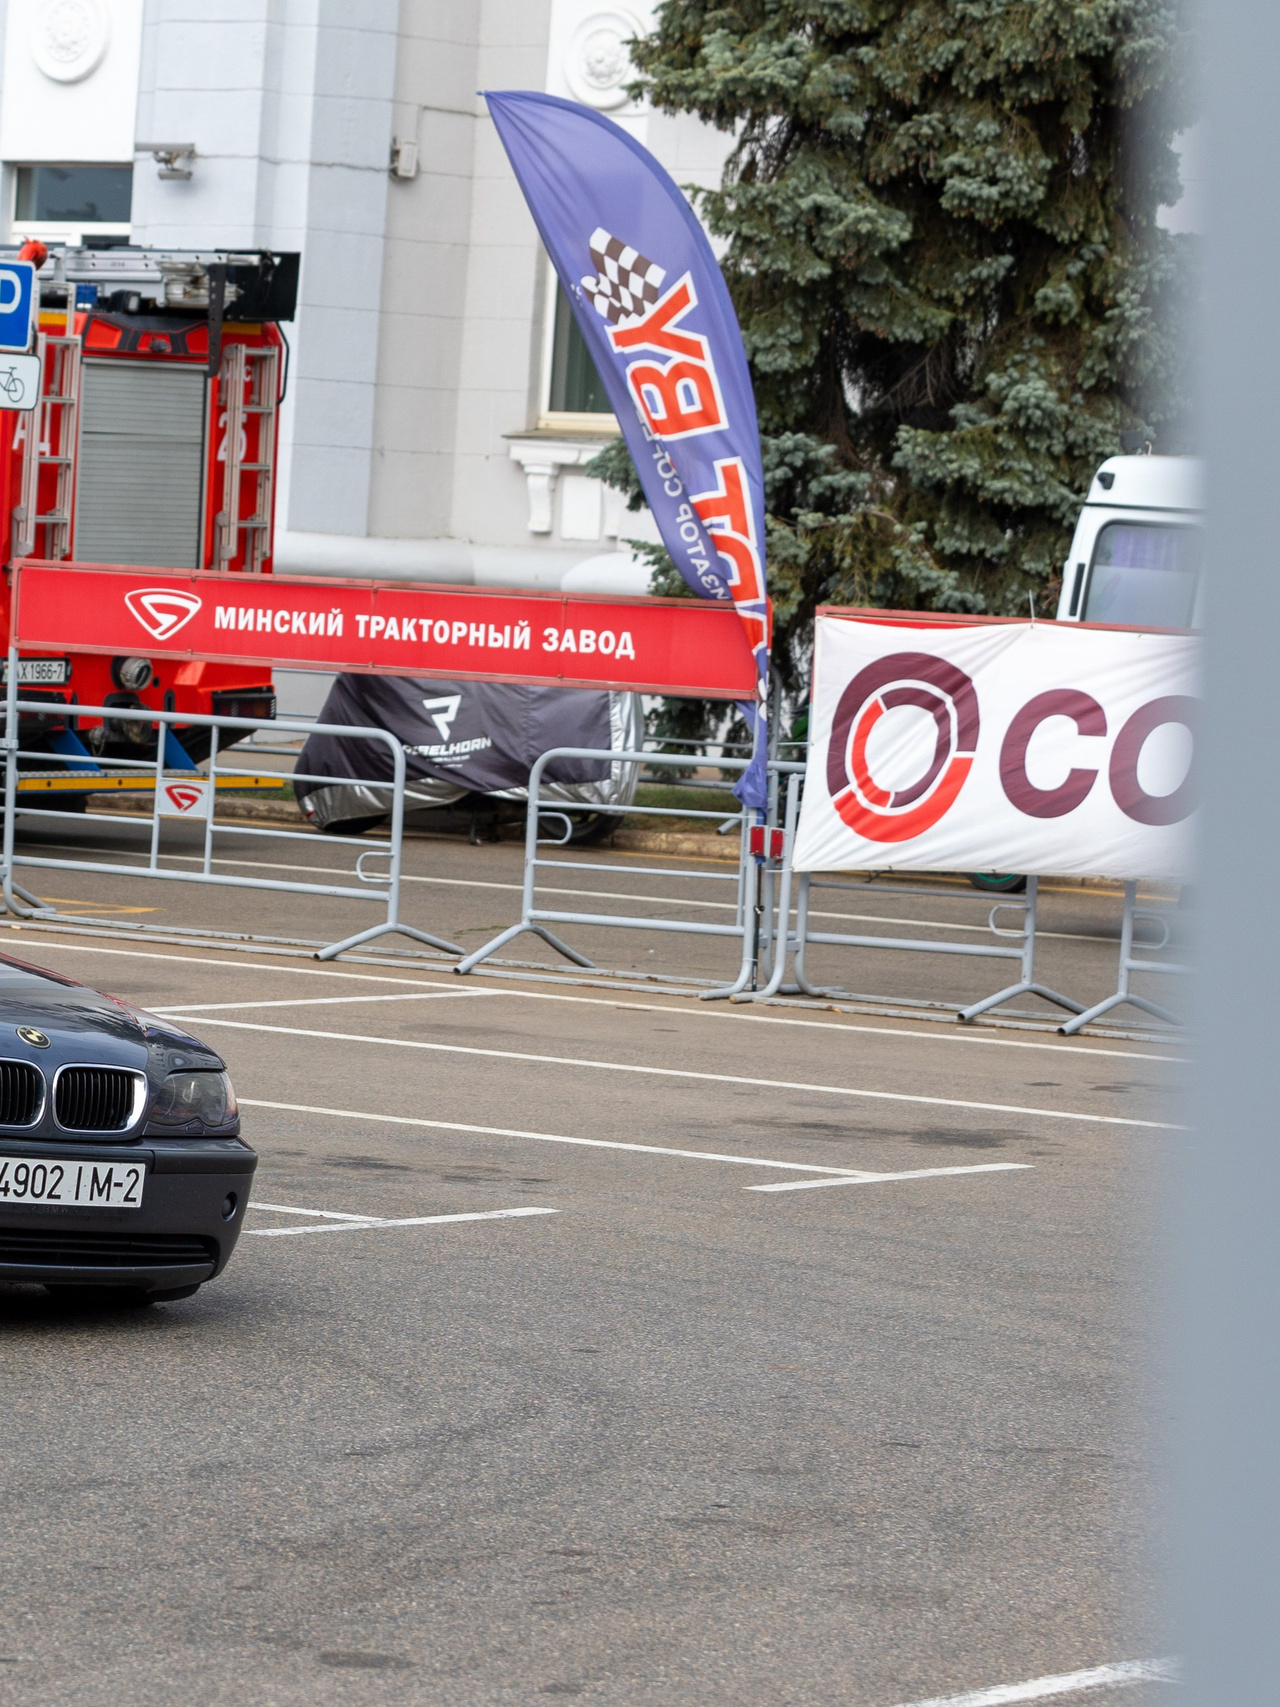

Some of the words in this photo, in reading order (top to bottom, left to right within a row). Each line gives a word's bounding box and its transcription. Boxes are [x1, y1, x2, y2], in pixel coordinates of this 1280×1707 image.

[214, 605, 344, 637] МИНСКИЙ
[355, 614, 531, 650] ТРАКТОРНЫЙ
[542, 627, 636, 661] ЗАВОД
[31, 663, 63, 680] 1966-7
